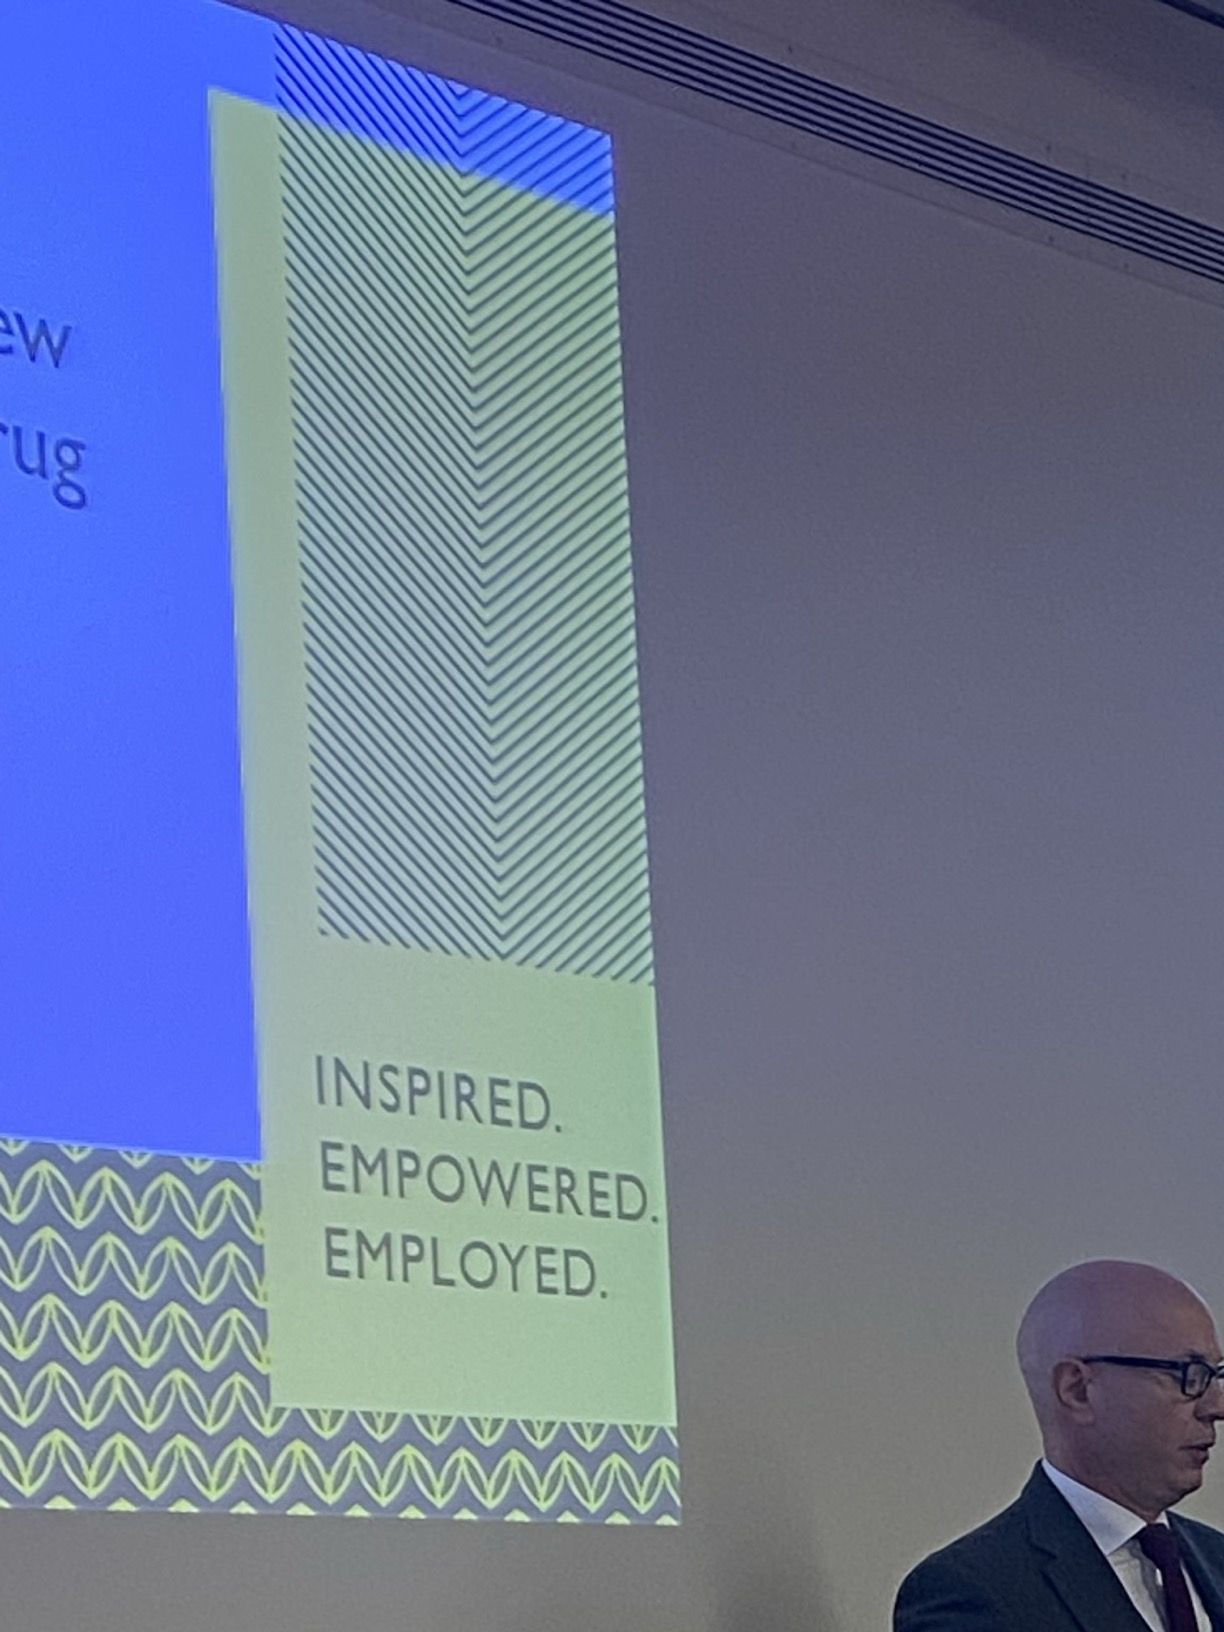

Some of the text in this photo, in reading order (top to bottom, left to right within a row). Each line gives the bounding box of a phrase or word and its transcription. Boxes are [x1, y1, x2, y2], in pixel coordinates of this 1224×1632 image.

[0, 422, 87, 510] ug
[315, 1054, 562, 1133] INSPIRED.
[320, 1140, 659, 1223] EMPOWERED.
[325, 1226, 608, 1299] EMPLOYED.
